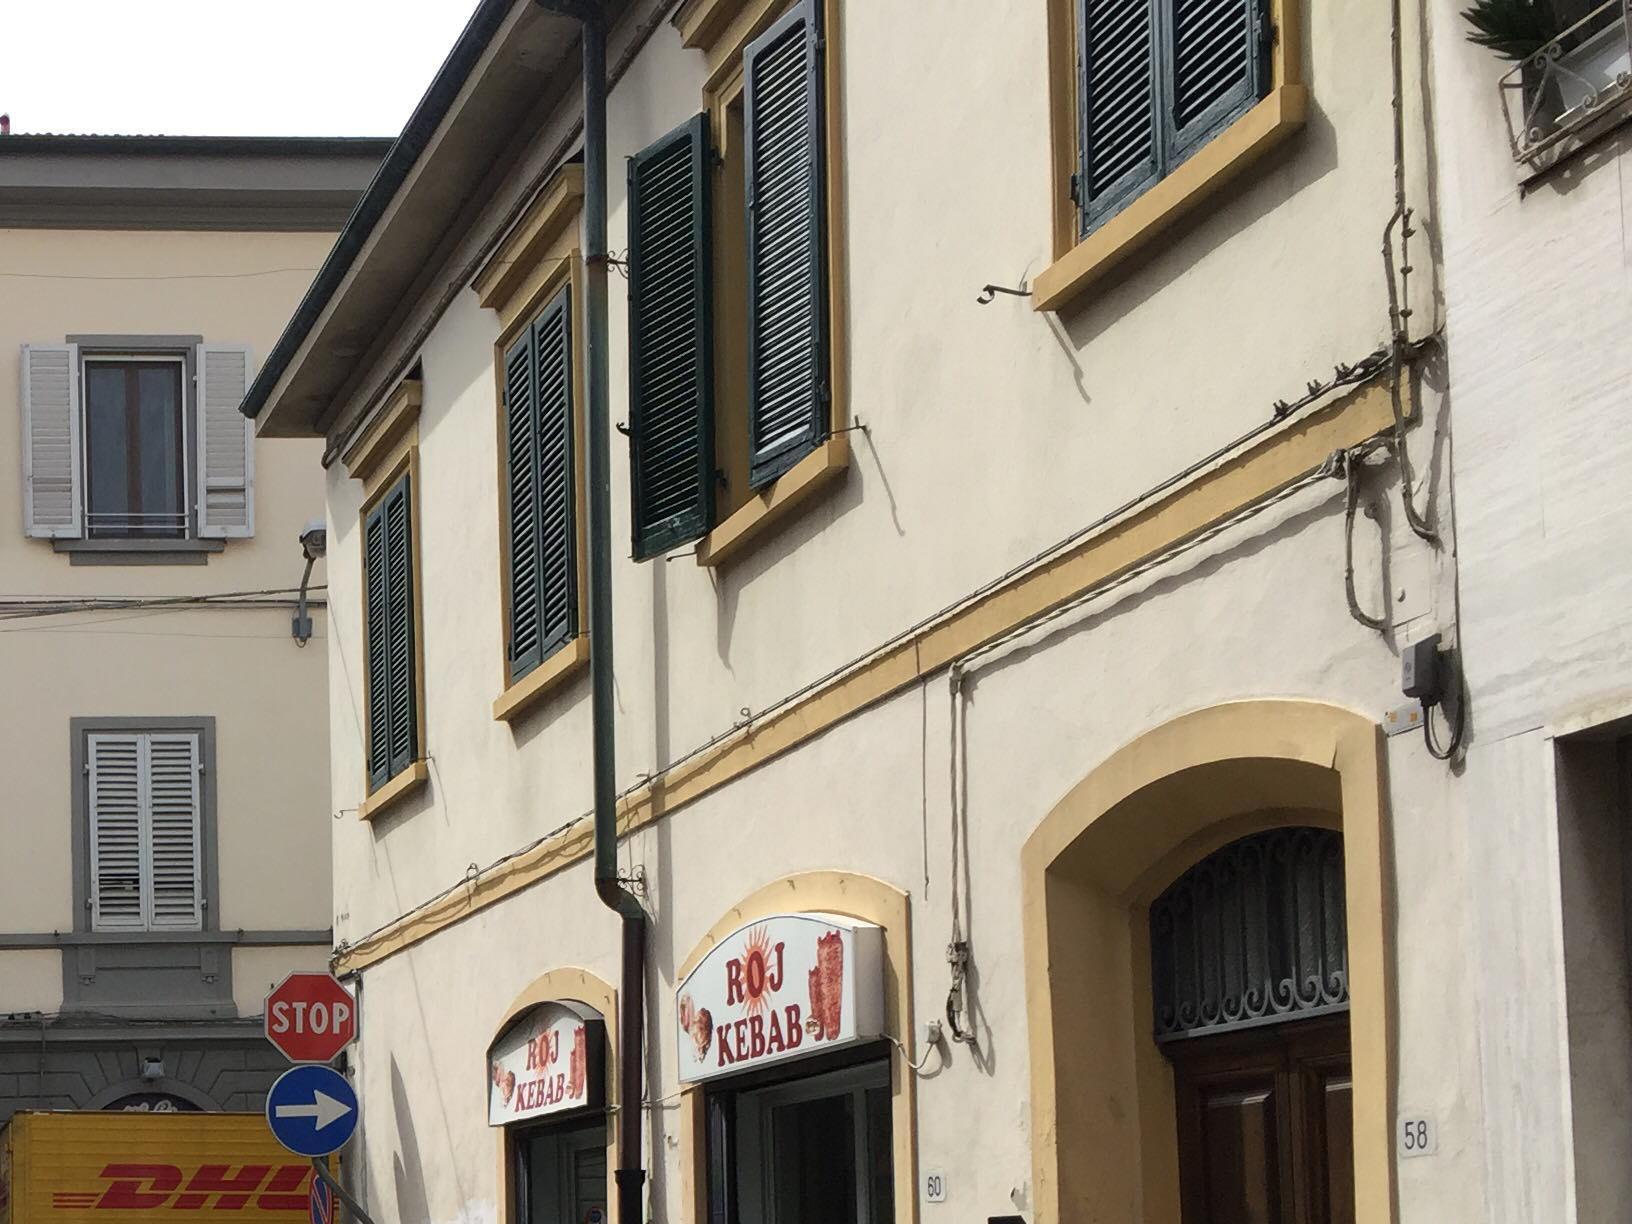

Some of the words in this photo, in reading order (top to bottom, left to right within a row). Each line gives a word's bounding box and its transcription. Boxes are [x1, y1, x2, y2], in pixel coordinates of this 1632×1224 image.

[726, 941, 786, 1006] ROJ
[271, 1000, 350, 1035] STOP
[717, 1004, 804, 1067] KEBAB
[526, 1030, 560, 1071] ROJ
[514, 1072, 566, 1113] KEBAB
[1403, 1120, 1430, 1151] 58
[94, 1163, 314, 1210] DHL
[926, 1175, 942, 1199] 60
